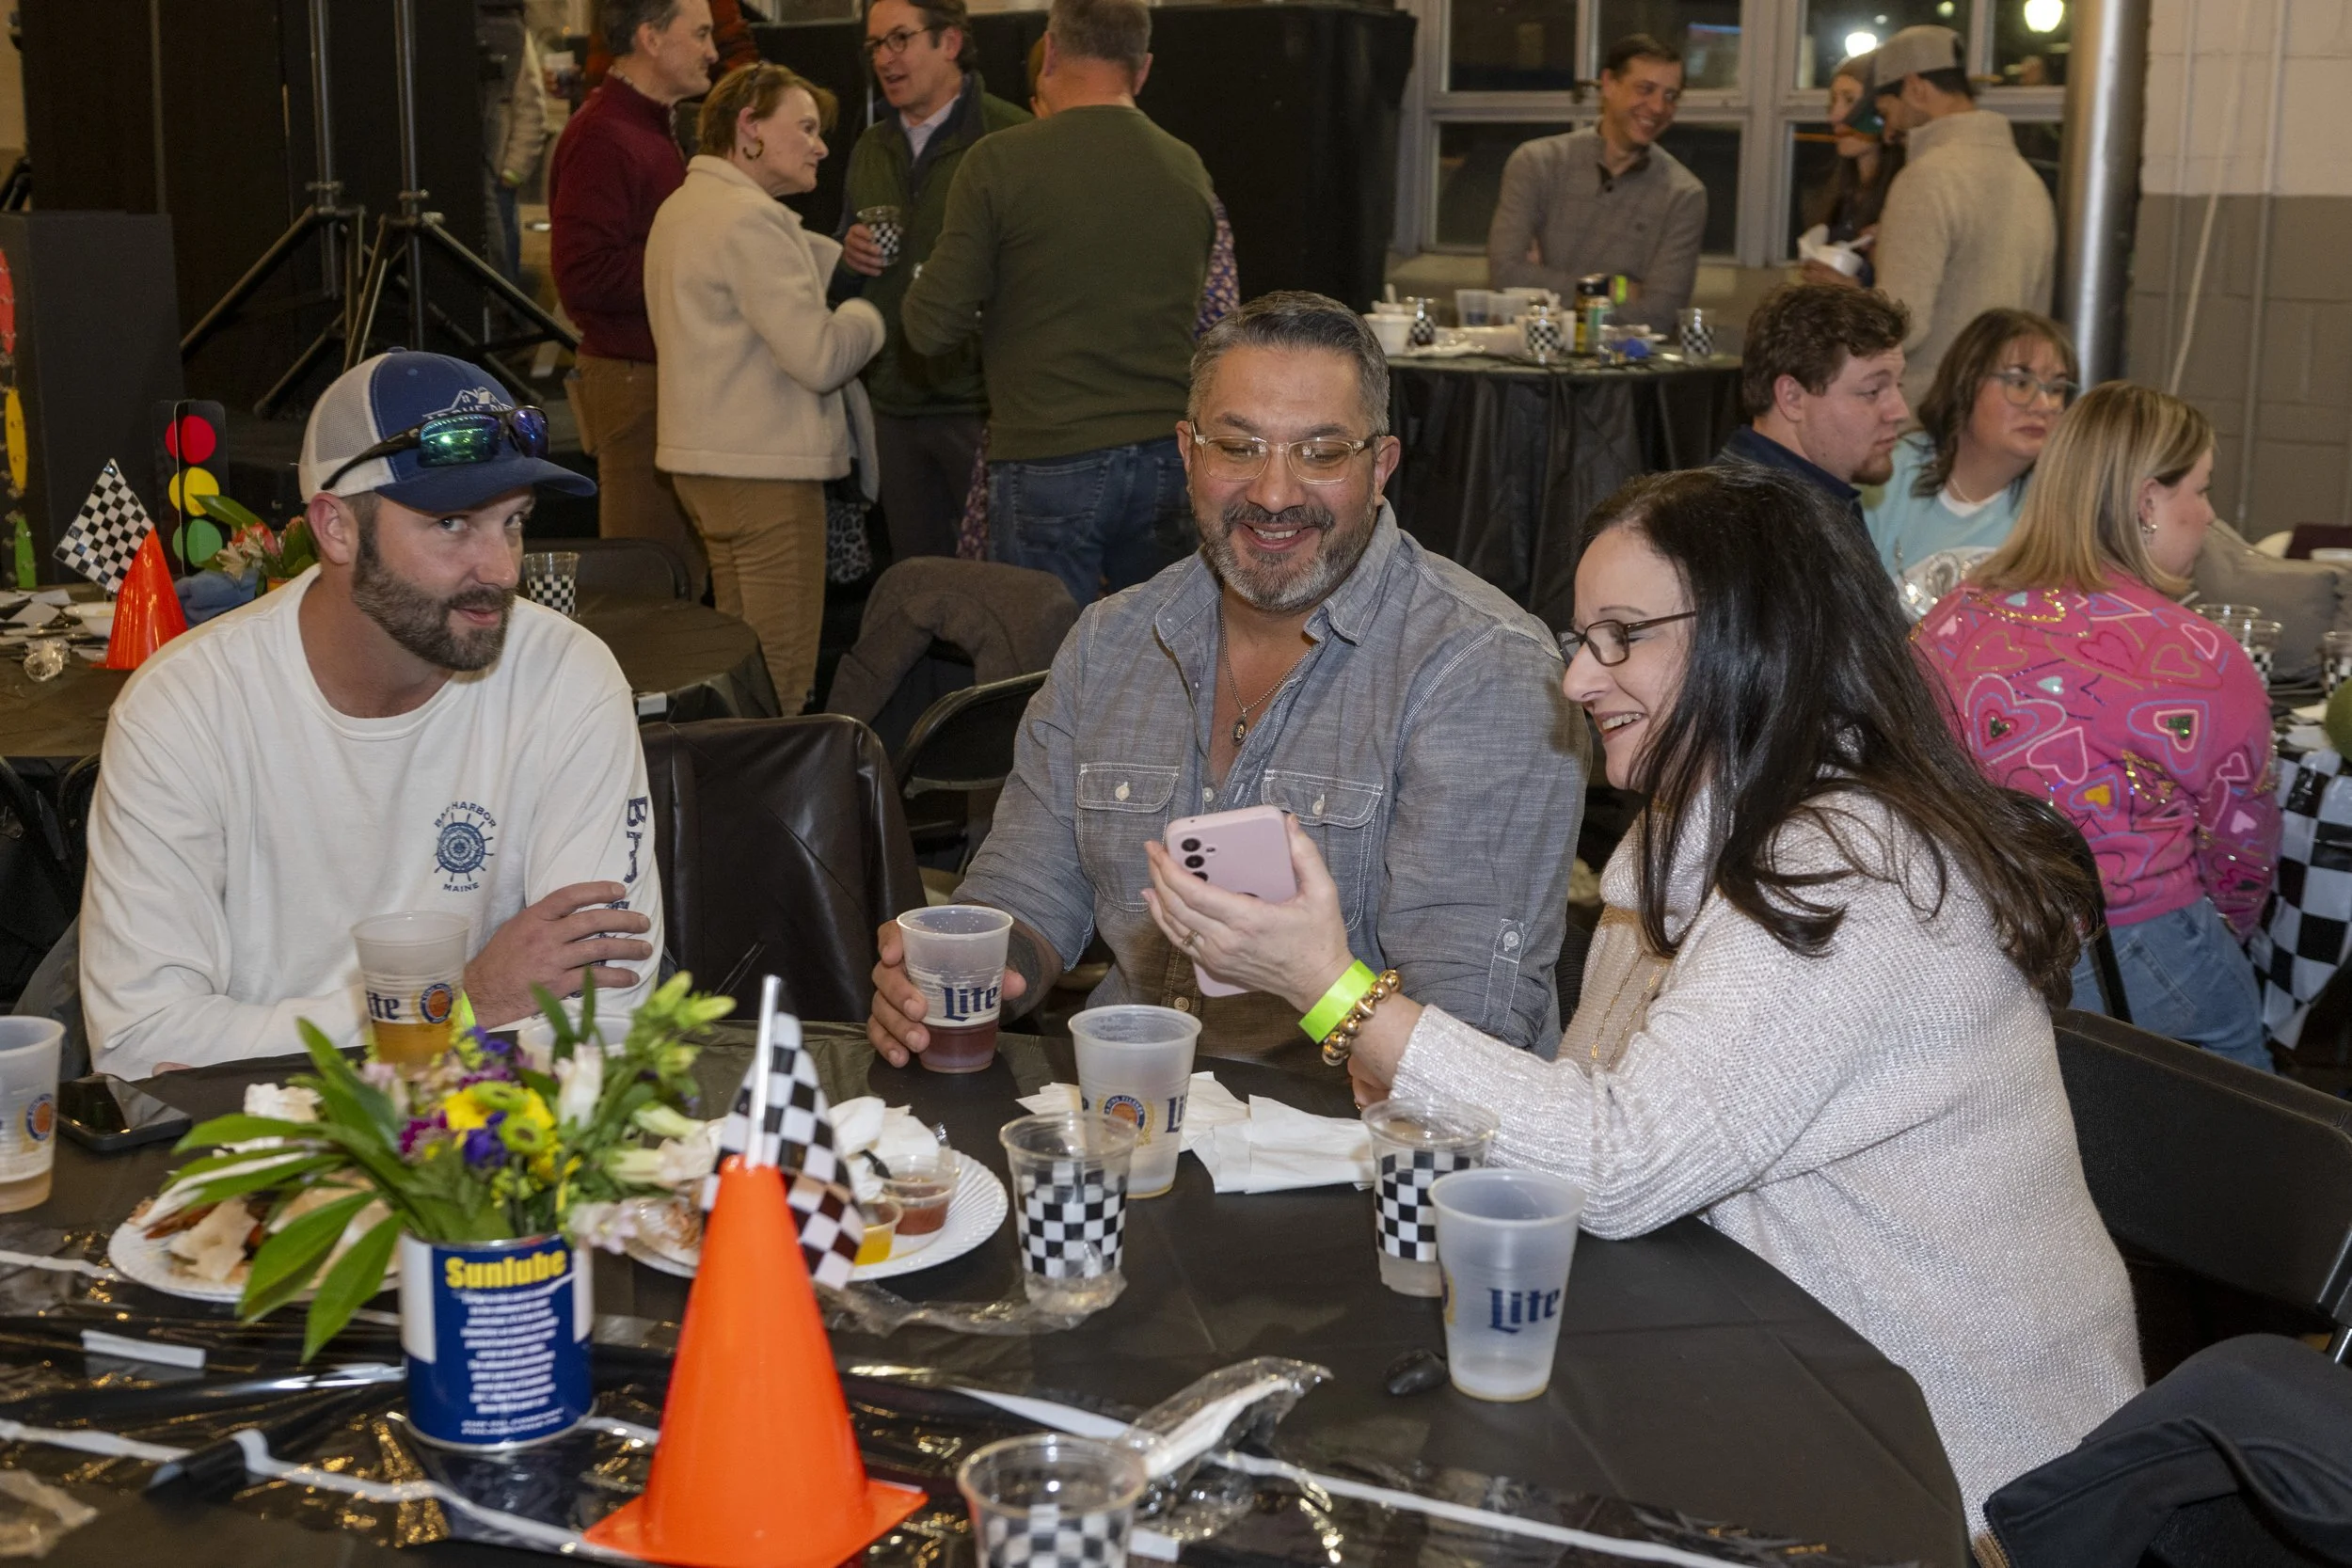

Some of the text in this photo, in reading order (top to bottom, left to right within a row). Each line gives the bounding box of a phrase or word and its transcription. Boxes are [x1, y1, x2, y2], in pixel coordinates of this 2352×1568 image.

[452, 800, 497, 828] HARBOR
[443, 881, 480, 893] MAINE
[366, 990, 400, 1021] ite
[941, 985, 998, 1022] Lite
[1165, 1095, 1185, 1133] Li
[445, 1250, 566, 1289] Sunlube
[1486, 1287, 1561, 1334] Lite
